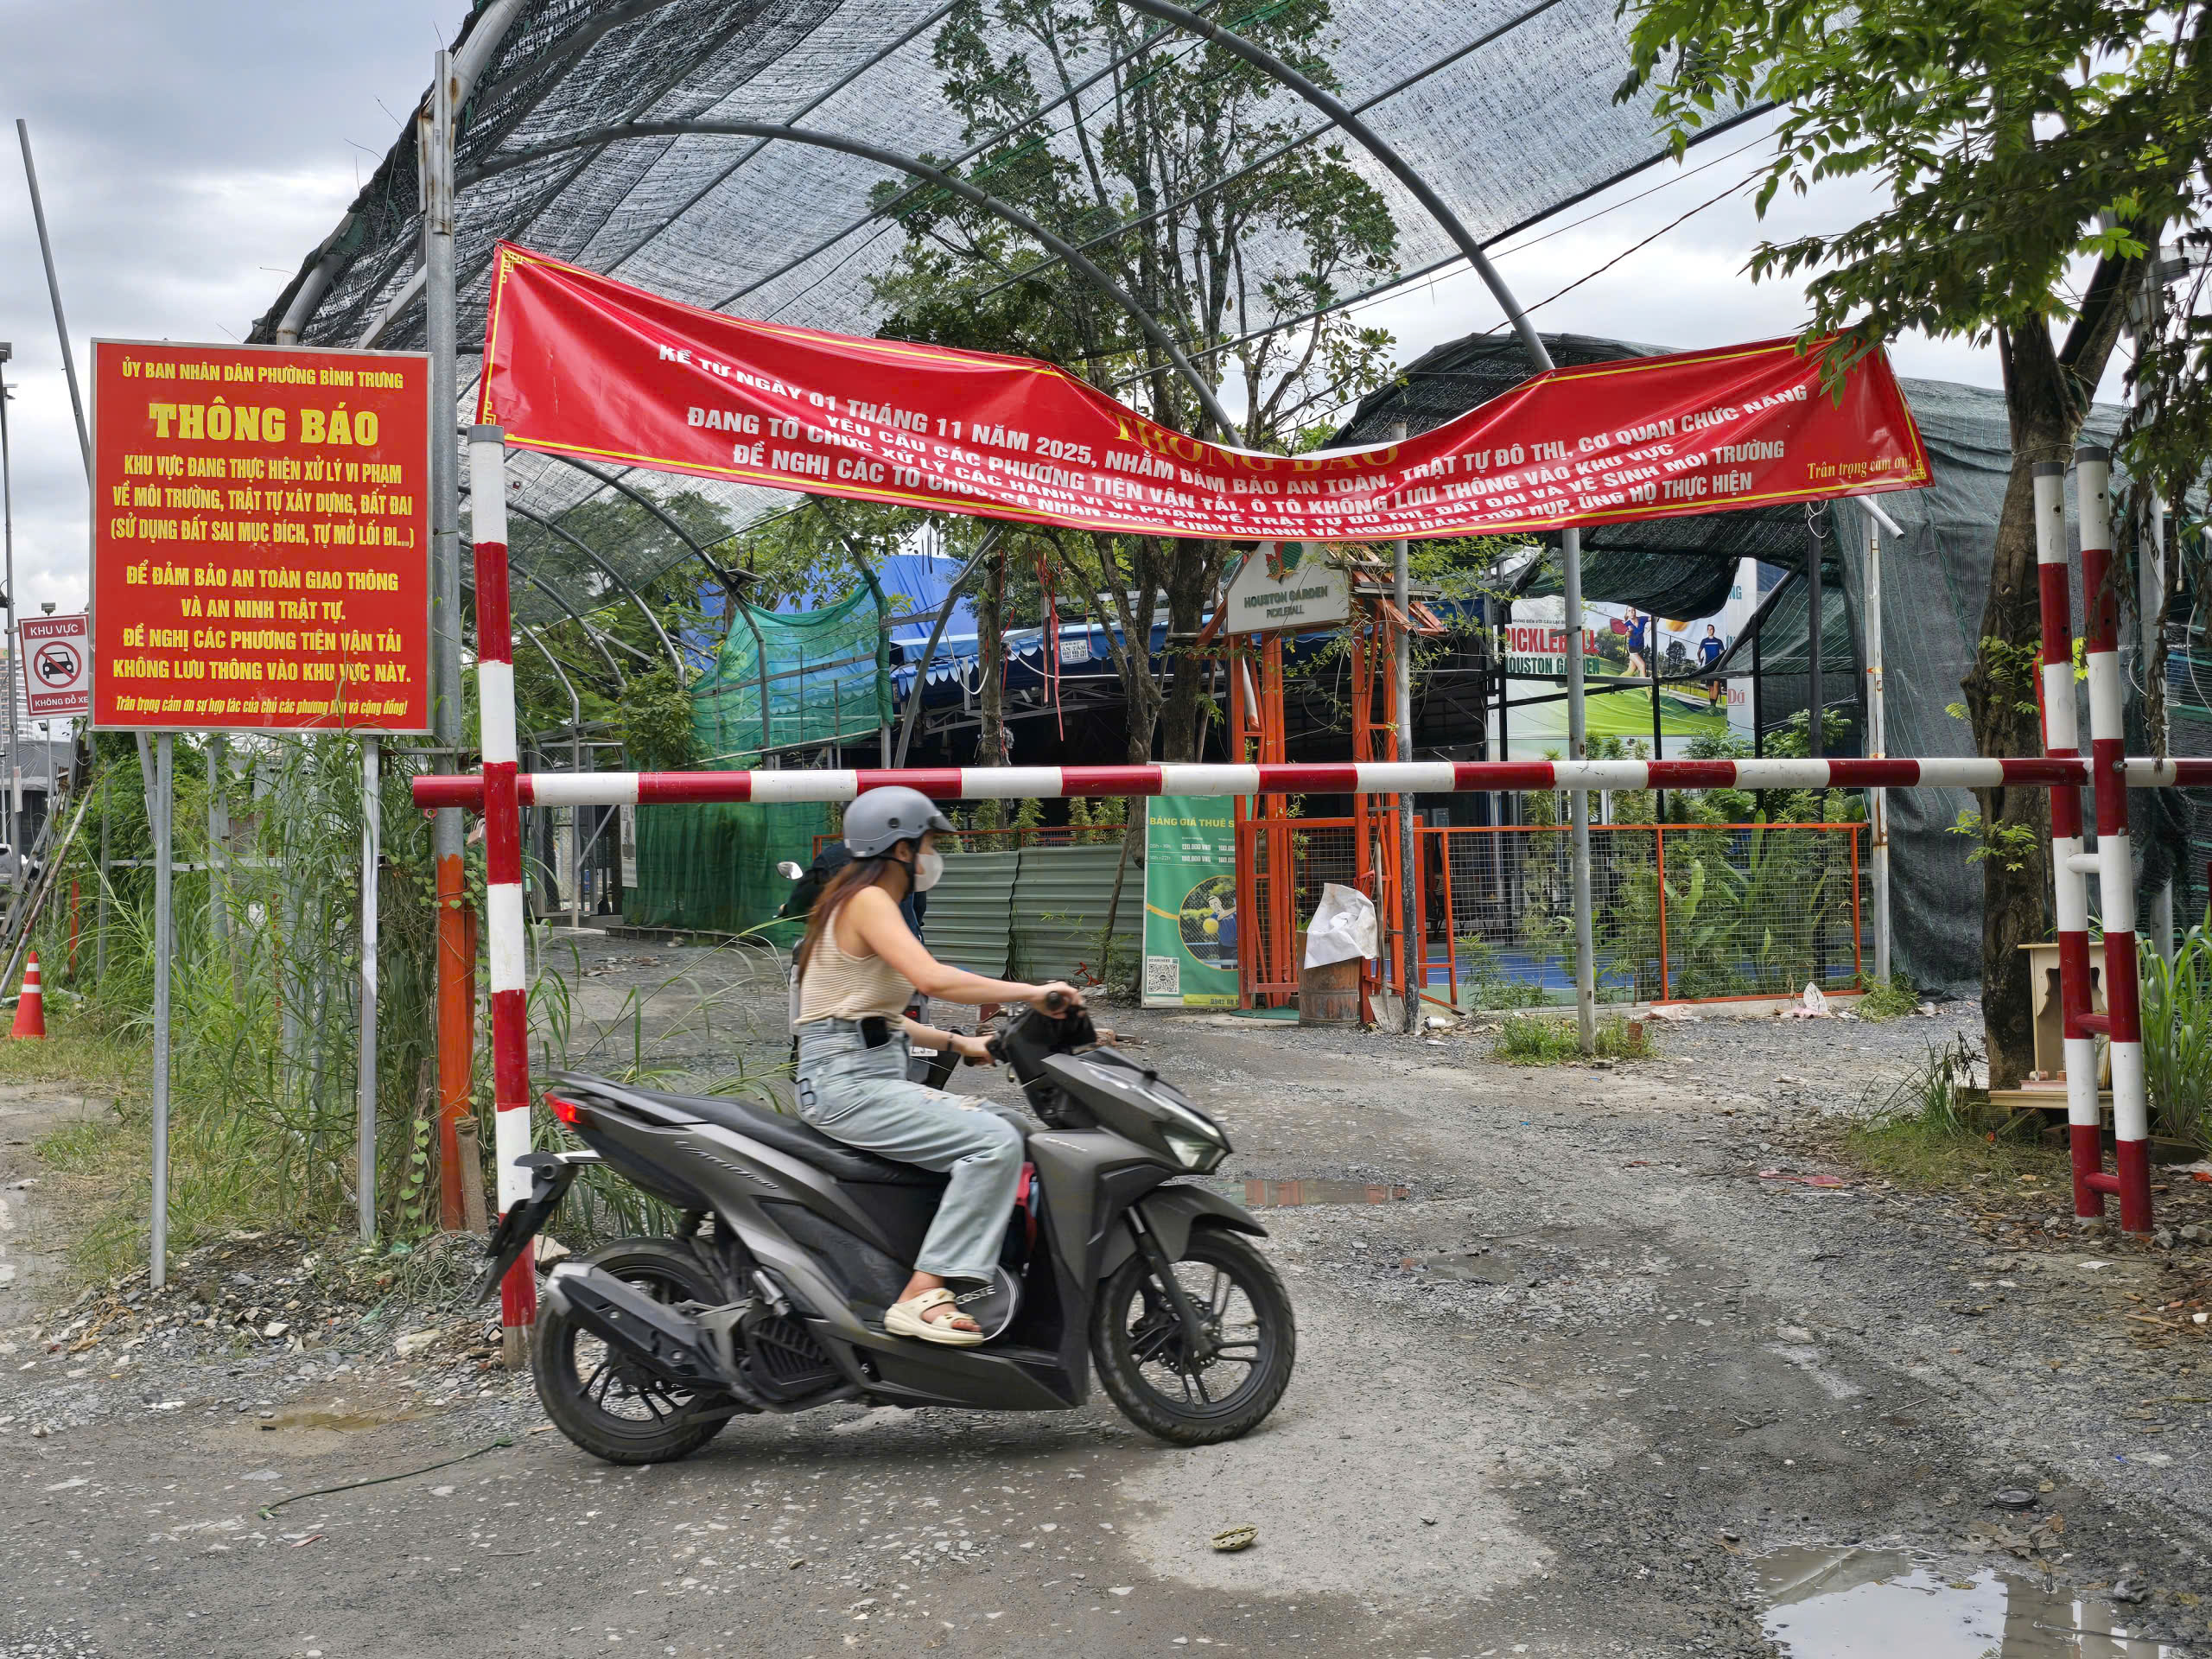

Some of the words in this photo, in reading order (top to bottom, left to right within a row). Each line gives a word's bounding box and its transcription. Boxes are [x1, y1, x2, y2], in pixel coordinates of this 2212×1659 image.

[123, 356, 141, 377] ỦY
[146, 363, 175, 378] BAN
[180, 362, 219, 380] NHÂN
[225, 363, 253, 382] DÂN
[258, 365, 315, 385] PHƯỜNG
[321, 367, 353, 386] BÌNH
[358, 372, 403, 388] TRƯNG
[149, 396, 285, 442] THÔNG
[301, 402, 378, 446] BÁO
[659, 344, 691, 365] KỂ
[698, 359, 731, 377] TỪ
[736, 371, 802, 399] NGÀY
[810, 392, 835, 411] 01
[848, 400, 927, 432] THÁNG
[938, 419, 961, 439] 11
[972, 424, 1028, 451] NĂM
[1036, 437, 1096, 467] 2025,
[1105, 450, 1173, 480] NHẰM
[1180, 469, 1225, 493] ĐẢM
[1234, 475, 1278, 494] BẢO
[1287, 482, 1318, 493] AN
[1329, 475, 1394, 493] TOÀN,
[1401, 456, 1456, 481] TRẬT
[1464, 449, 1490, 473] TỰ
[1496, 443, 1524, 467] ĐÔ
[1531, 441, 1573, 461] THỊ,
[1579, 433, 1610, 452] CƠ
[1616, 419, 1675, 444] QUAN
[1682, 408, 1738, 432] CHỨC
[1743, 385, 1807, 414] NĂNG
[124, 455, 152, 475] KHU
[157, 454, 183, 480] VỰC
[188, 457, 226, 477] ĐANG
[230, 457, 264, 482] THỰC
[269, 456, 300, 484] HIỆN
[304, 455, 324, 480] XỬ
[327, 459, 342, 481] LÝ
[346, 463, 358, 482] VI
[363, 463, 401, 487] PHẠM
[688, 407, 759, 434] ĐANG
[768, 415, 799, 439] TỔ
[807, 425, 873, 452] CHỨC
[881, 447, 914, 464] XỬ
[920, 458, 946, 474] LÝ
[955, 467, 1002, 486] CÁC
[1009, 480, 1075, 501] HÀNH
[1081, 495, 1103, 506] VI
[1109, 500, 1133, 511] VI
[1140, 505, 1208, 519] PHẠM
[1249, 517, 1305, 526] TRẬT
[1313, 518, 1341, 526] TỰ
[1435, 500, 1478, 515] ĐẤT
[1485, 493, 1527, 507] ĐAI
[1530, 486, 1564, 499] VÀ
[1602, 467, 1659, 486] SINH
[1663, 453, 1707, 472] MÔI
[1711, 441, 1783, 463] TRƯỜNG
[825, 415, 870, 436] YÊU
[879, 431, 925, 452] CẦU
[934, 446, 980, 466] CÁC
[988, 456, 1084, 491] PHƯƠNG
[1092, 476, 1143, 500] TIỆN
[1149, 487, 1194, 508] VẬN
[1202, 496, 1244, 512] TẢI,
[1251, 499, 1266, 512] Ô
[1272, 499, 1302, 513] TÔ
[1308, 496, 1387, 514] KHÔNG
[1395, 487, 1438, 509] LƯU
[1443, 474, 1521, 499] THÔNG
[1522, 467, 1570, 485] VÀO
[1576, 456, 1623, 475] KHU
[1626, 444, 1673, 461] VỰC
[1808, 461, 1835, 479] Trân
[1839, 459, 1867, 479] trọng
[113, 480, 130, 505] VỀ
[135, 484, 161, 507] MÔI
[165, 485, 224, 512] TRƯỜNG,
[228, 486, 261, 514] TRẬT
[265, 490, 283, 515] TỰ
[286, 488, 312, 512] XÂY
[316, 492, 357, 517] DỰNG,
[360, 488, 386, 514] ĐẤT
[390, 496, 411, 515] ĐAI
[111, 512, 137, 539] (SỬ
[139, 519, 177, 543] DỤNG
[181, 514, 207, 540] ĐẤT
[212, 521, 233, 541] SAI
[238, 522, 271, 546] MỤC
[273, 519, 308, 545] ĐÍCH,
[313, 523, 331, 548] TỰ
[334, 519, 355, 544] MỞ
[359, 519, 379, 545] LỐI
[127, 560, 148, 584] ĐỂ
[152, 562, 188, 586] ĐẢM
[195, 563, 226, 586] BẢO
[232, 569, 254, 587] AN
[259, 567, 300, 588] TOÀN
[306, 571, 341, 589] GIAO
[346, 569, 398, 590] THÔNG
[181, 595, 202, 616] VÀ
[207, 600, 229, 617] AN
[235, 601, 274, 618] NINH
[279, 598, 317, 623] TRẬT
[321, 601, 346, 624] TỰ.
[1244, 591, 1287, 608] HOUSTON
[1289, 586, 1328, 601] GARDEN
[1267, 605, 1305, 618] PICKLEBALL
[31, 624, 53, 636] KHU
[56, 623, 79, 636] VỰC
[124, 623, 144, 646] ĐỀ
[149, 629, 188, 652] NGHỊ
[194, 626, 226, 648] CÁC
[232, 630, 296, 650] PHƯƠNG
[301, 629, 335, 654] TIỆN
[341, 630, 372, 654] VẬN
[377, 628, 401, 652] TẢI
[114, 657, 168, 677] KHÔNG
[175, 659, 204, 678] LƯU
[209, 658, 262, 680] THÔNG
[267, 659, 297, 680] VÀO
[303, 664, 334, 681] KHU
[340, 663, 370, 684] VỰC
[375, 664, 410, 682] NÀY.
[35, 696, 63, 707] KHÔNG
[117, 696, 136, 710] Trân
[137, 697, 160, 714] trọng
[162, 696, 181, 711] cảm
[196, 699, 208, 715] sự
[207, 698, 225, 715] hợp
[227, 698, 241, 712] tác
[243, 696, 259, 713] của
[261, 696, 277, 713] chủ
[279, 698, 295, 713] các
[296, 699, 328, 717] phương
[349, 699, 359, 714] và
[360, 700, 382, 716] cộng
[384, 698, 408, 715] đồng!
[1149, 816, 1177, 826] BẢNG
[1179, 817, 1197, 826] GIÁ
[1198, 817, 1225, 828] THUÊ
